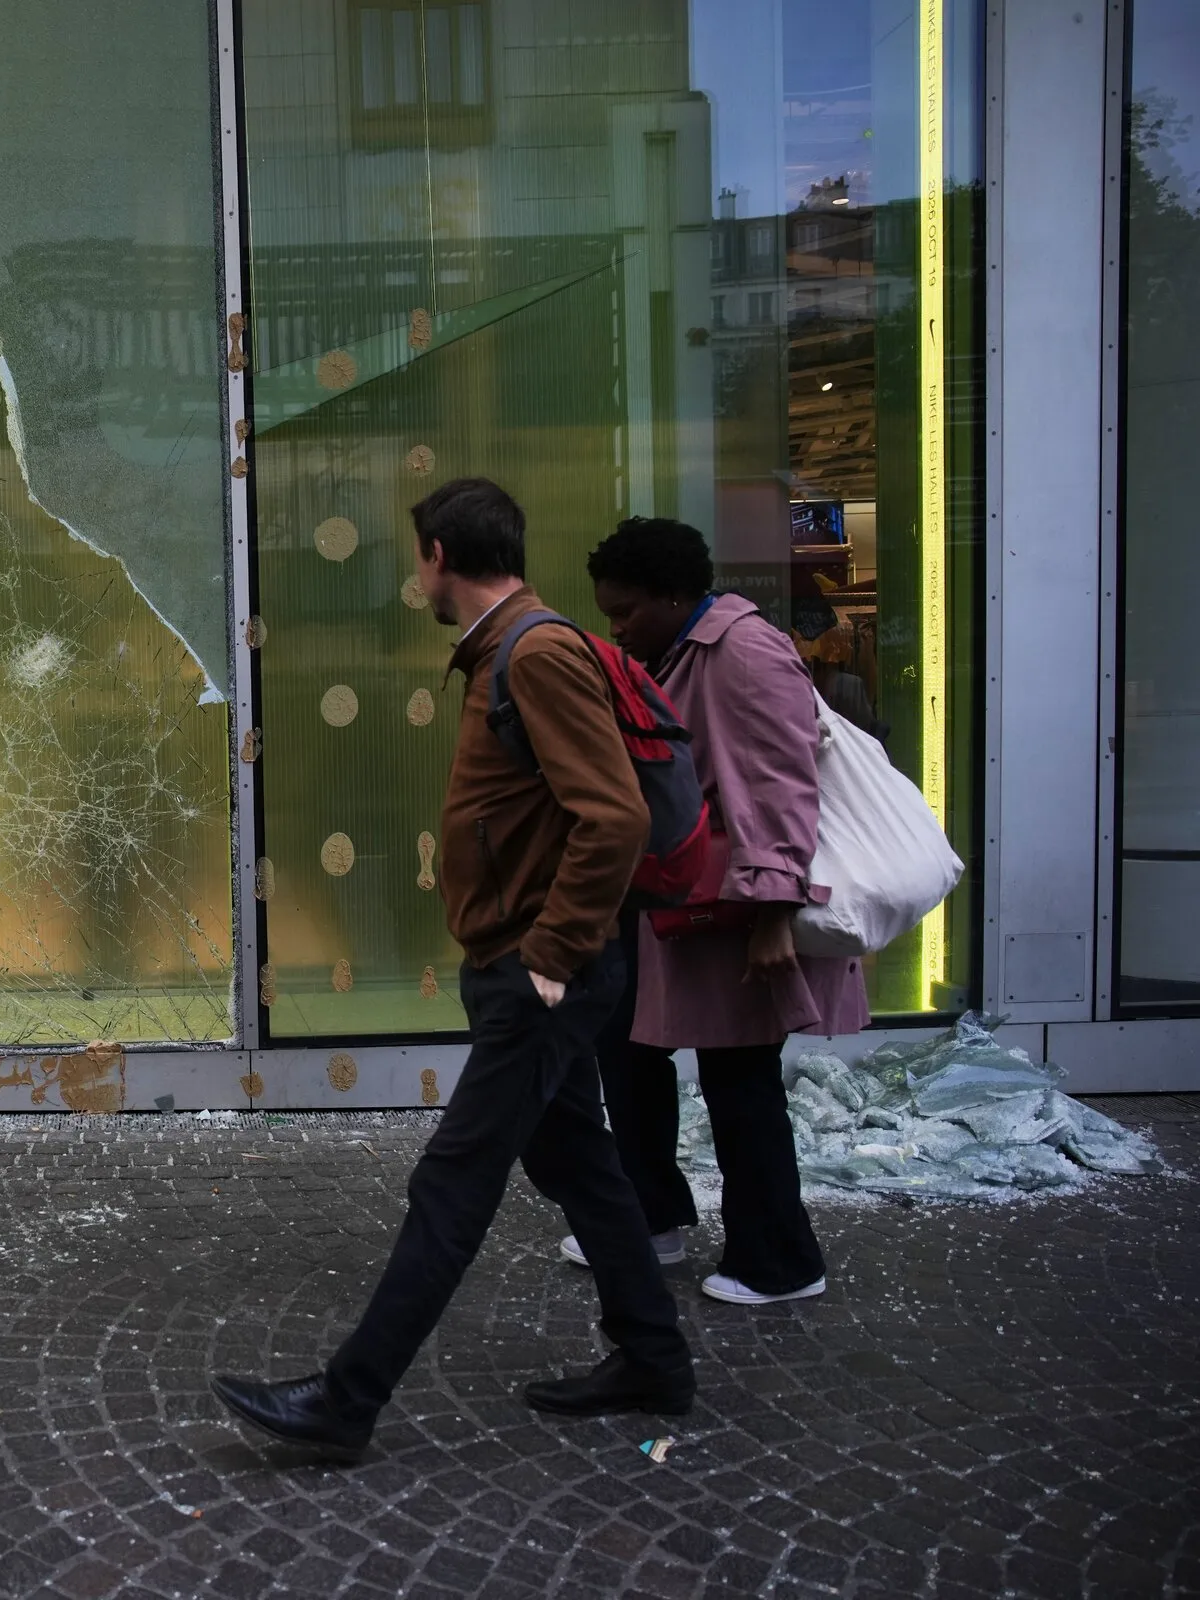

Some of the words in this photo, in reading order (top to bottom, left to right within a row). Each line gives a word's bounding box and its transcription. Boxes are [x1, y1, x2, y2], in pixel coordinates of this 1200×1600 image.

[928, 45, 936, 81] LES
[928, 83, 936, 153] HALLES
[928, 179, 936, 221] 2026
[928, 224, 936, 261] OCT
[929, 267, 936, 287] 19
[929, 384, 937, 425] NIKE
[930, 467, 938, 534] HALLES
